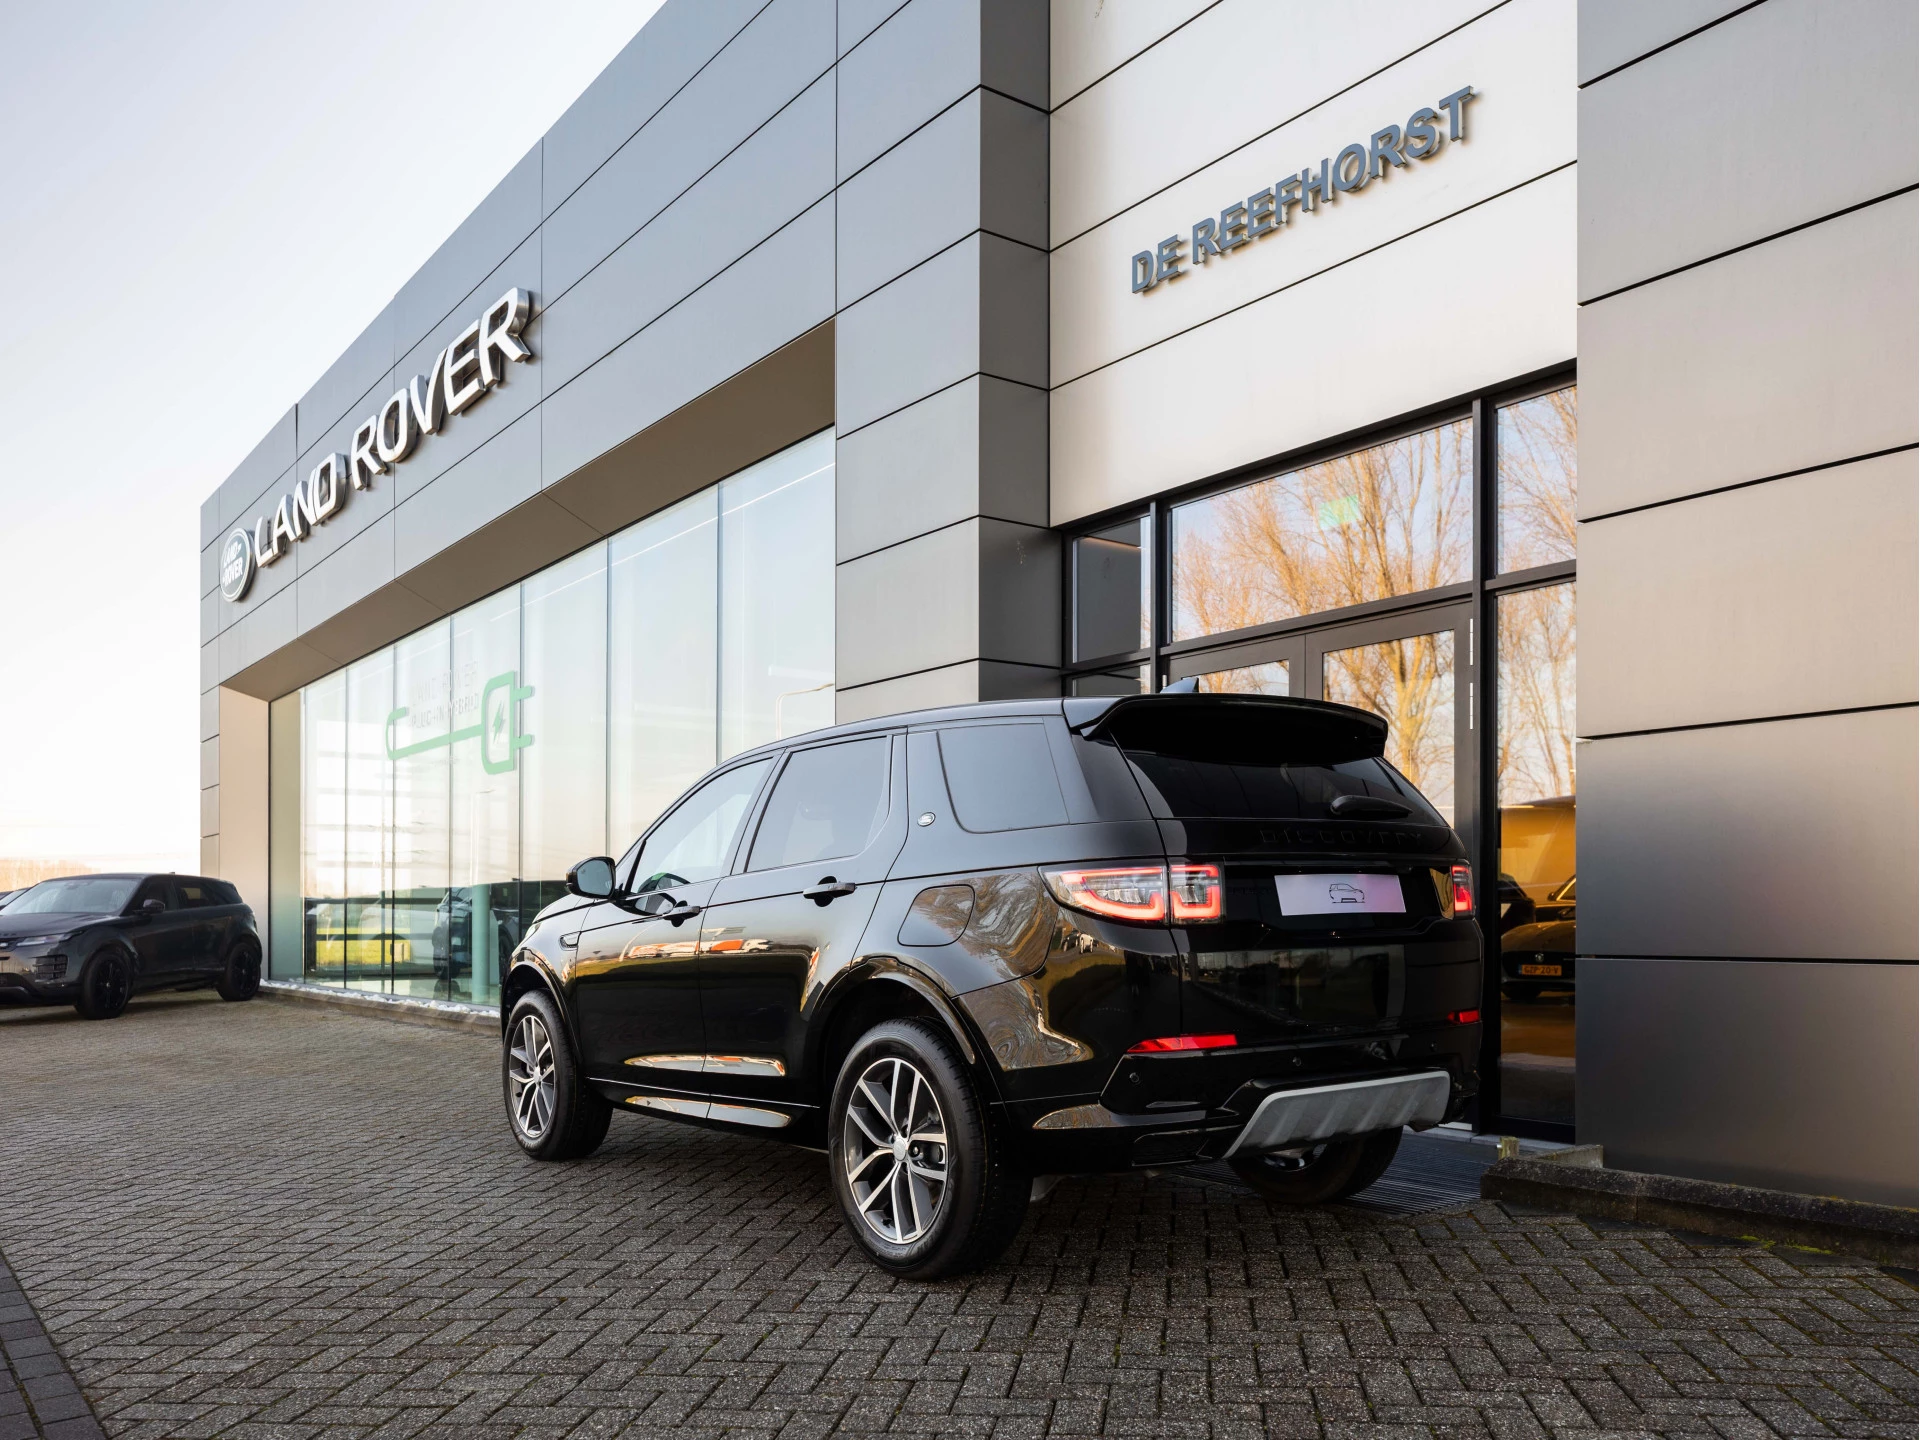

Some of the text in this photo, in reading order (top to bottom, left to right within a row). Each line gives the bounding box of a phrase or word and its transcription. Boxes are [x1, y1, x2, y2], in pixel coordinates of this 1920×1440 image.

[1131, 85, 1475, 294] DE REEFHORST
[254, 287, 531, 568] LAND ROVER
[222, 556, 243, 588] ROVER
